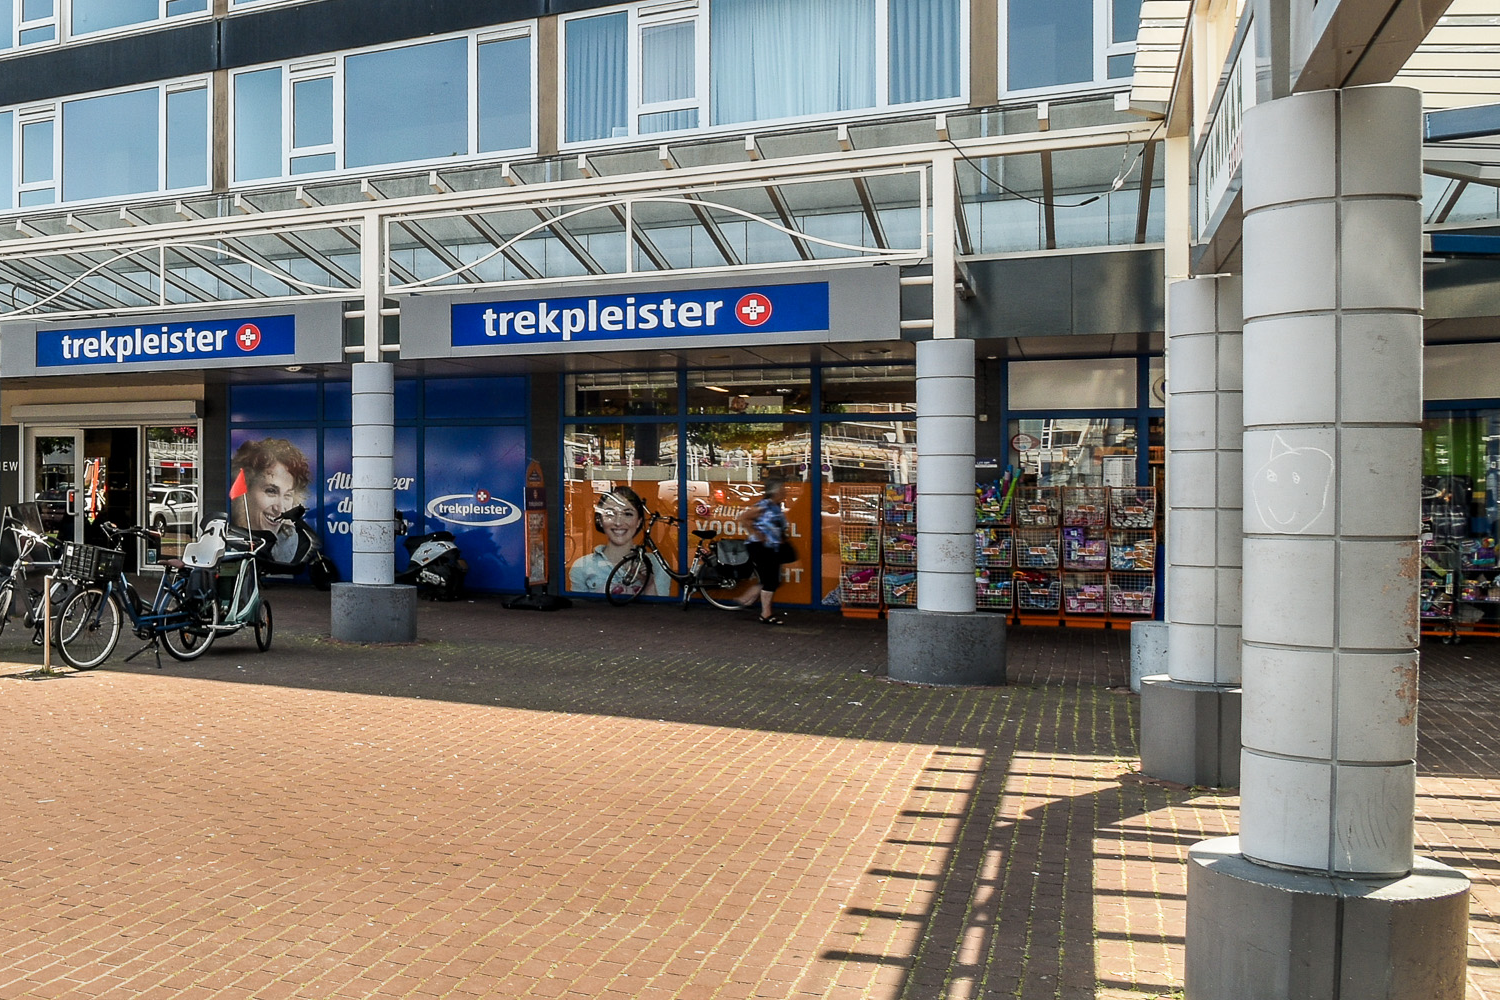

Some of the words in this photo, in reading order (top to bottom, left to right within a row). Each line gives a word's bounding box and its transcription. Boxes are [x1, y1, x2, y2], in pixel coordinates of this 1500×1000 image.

[483, 297, 723, 341] trekpleister
[61, 326, 228, 363] trekpleister
[438, 502, 508, 516] trekpleister
